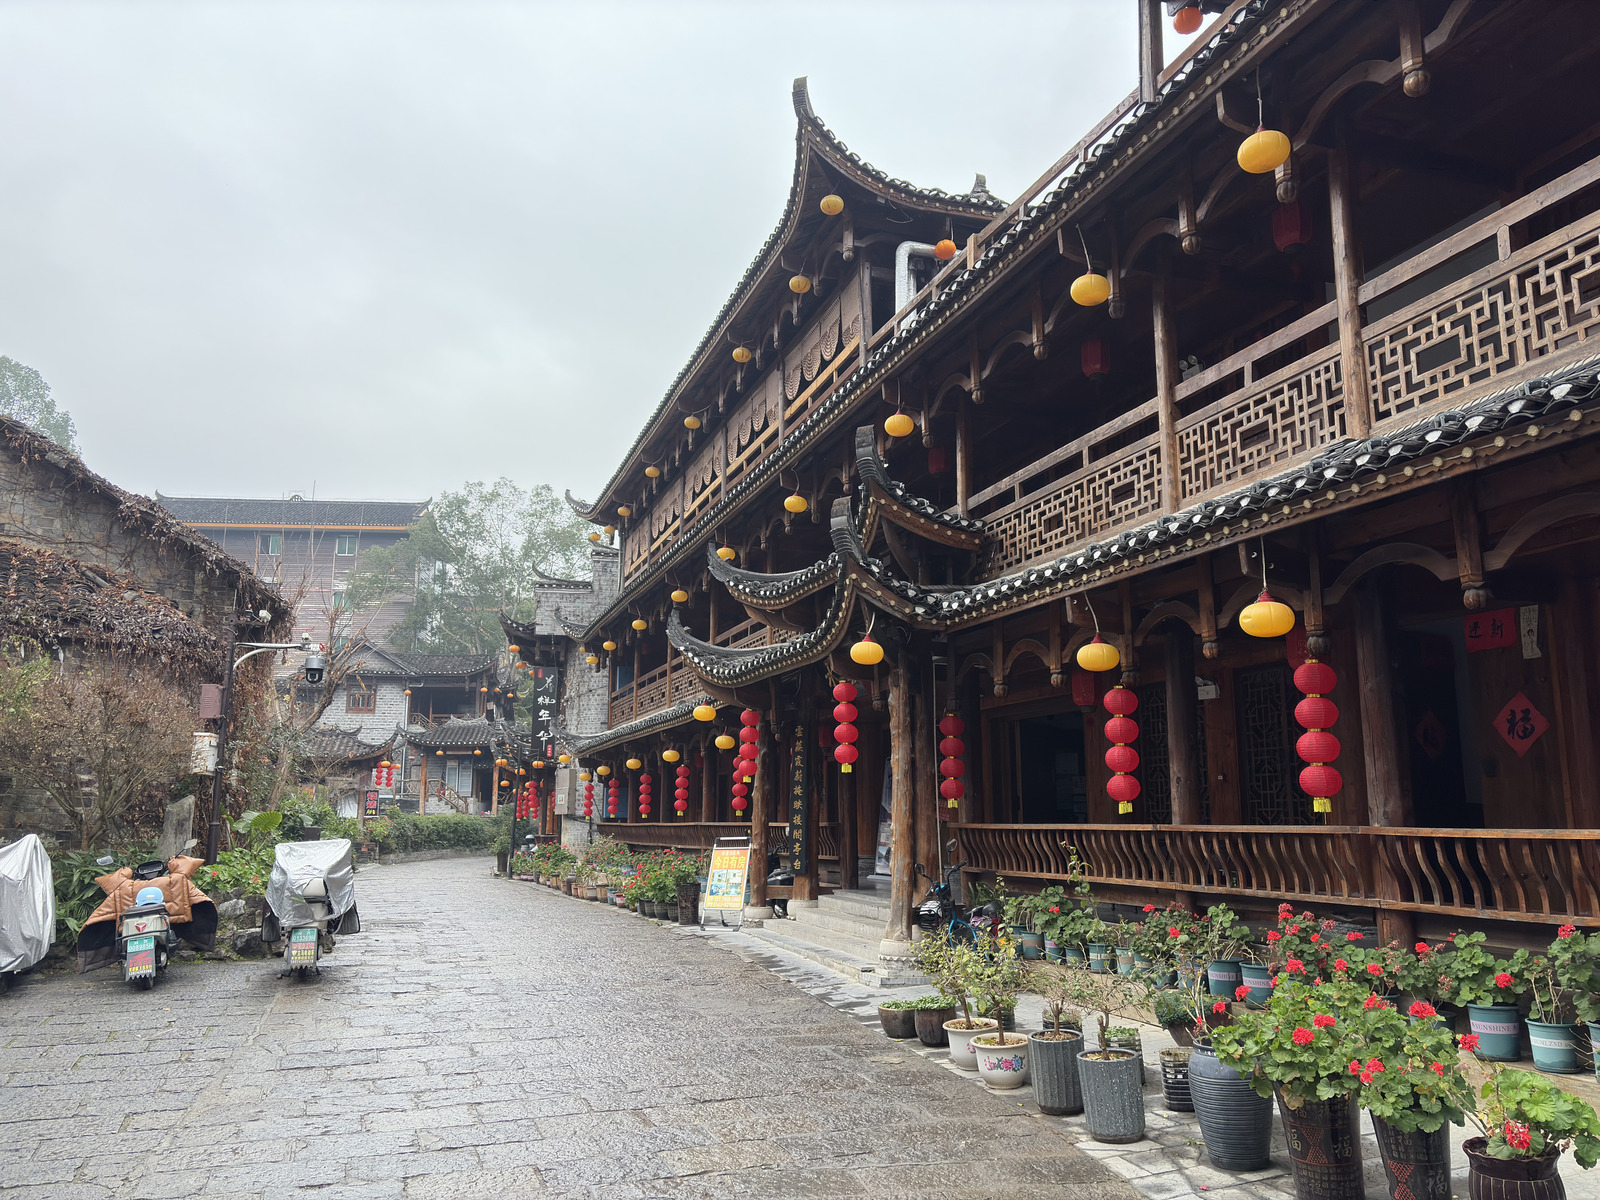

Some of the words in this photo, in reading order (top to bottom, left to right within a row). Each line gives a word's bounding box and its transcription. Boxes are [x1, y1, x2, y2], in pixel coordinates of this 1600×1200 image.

[1506, 708, 1535, 739] 福
[714, 855, 746, 869] 今日有房
[1475, 1023, 1511, 1032] SUNSHINE
